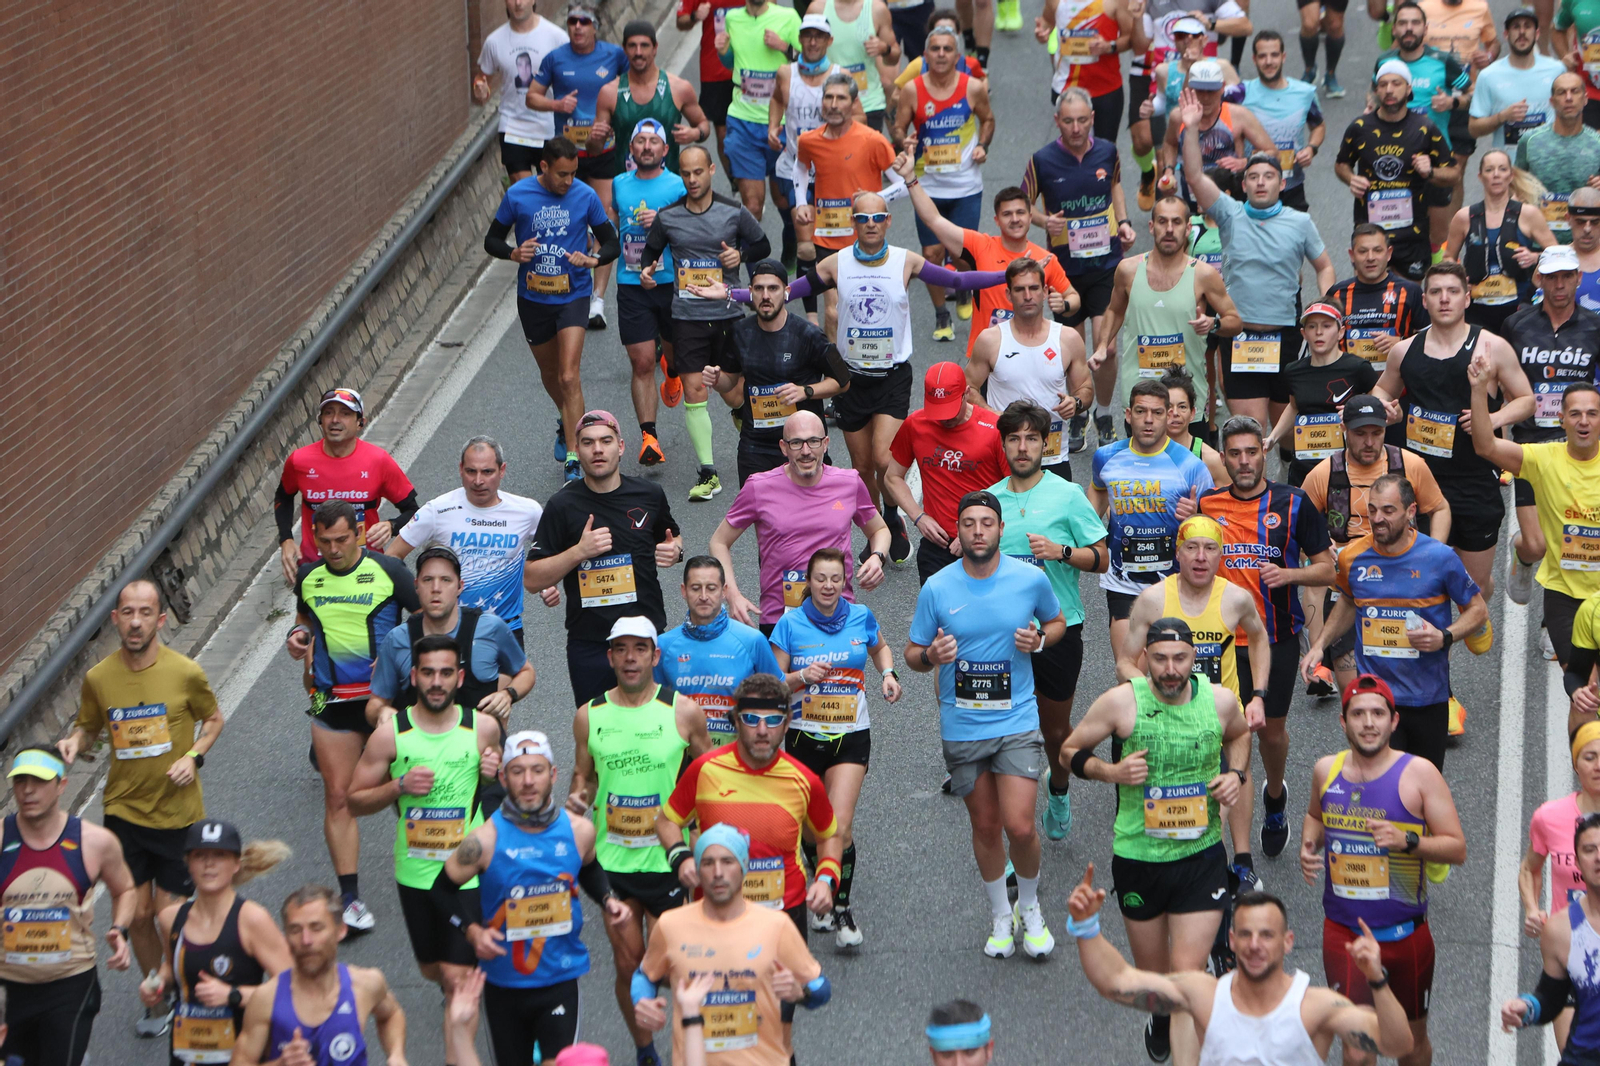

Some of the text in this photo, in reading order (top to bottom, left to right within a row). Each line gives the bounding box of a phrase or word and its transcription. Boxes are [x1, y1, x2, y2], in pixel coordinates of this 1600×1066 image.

[1382, 190, 1406, 199] ZURICH
[1082, 218, 1105, 227] ZURICH
[541, 255, 556, 266] DE
[692, 260, 718, 268] ZURICH
[535, 264, 562, 275] OROS
[861, 329, 889, 338] ZURICH
[1151, 335, 1179, 344] ZURICH
[861, 343, 878, 351] 8795
[1521, 346, 1593, 367] Heróis
[1555, 368, 1588, 378] BETANO
[762, 400, 778, 409] 5481
[1309, 415, 1337, 424] ZURICH
[1423, 411, 1451, 424] ZURICH
[1309, 430, 1326, 439] 6062
[1422, 437, 1434, 445] TOM
[1109, 479, 1162, 498] TEAM
[306, 489, 369, 500] Los Lentos
[1113, 497, 1167, 516] BUGUE
[471, 519, 508, 528] Sabadell
[1137, 527, 1166, 536] ZURICH
[450, 532, 520, 549] MADRID
[1136, 543, 1155, 551] 2546
[1580, 542, 1600, 551] 4253
[461, 548, 507, 558] CORRE POR
[1561, 552, 1587, 561] ANDRES
[594, 557, 625, 568] ZURICH
[1134, 555, 1159, 563] OLMEDO
[596, 574, 615, 583] 5474
[1381, 609, 1407, 618] ZURIC
[1380, 626, 1400, 635] 4662
[793, 650, 849, 667] enerplus
[972, 663, 1005, 672] ZURICH
[676, 675, 735, 689] enerplus
[971, 679, 992, 689] 2775
[822, 685, 851, 694] ZURICH
[975, 691, 989, 700] XUS
[820, 701, 840, 711] 4443
[126, 705, 160, 719] ZURICH
[805, 713, 854, 722] ARACELI AMARO
[606, 753, 651, 771] CORRE
[621, 762, 666, 777] DE NOCHE
[1166, 786, 1200, 798] ZURICH
[622, 796, 655, 807] ZURICH
[425, 808, 461, 819] ZURICH
[1158, 820, 1177, 828] ALEX
[1345, 843, 1381, 855] ZURICH
[749, 859, 778, 870] URICH
[1343, 877, 1370, 887] CARLOS
[527, 882, 563, 896] ZURICH
[25, 910, 63, 921] ZURICH
[711, 992, 749, 1005] ZURICH
